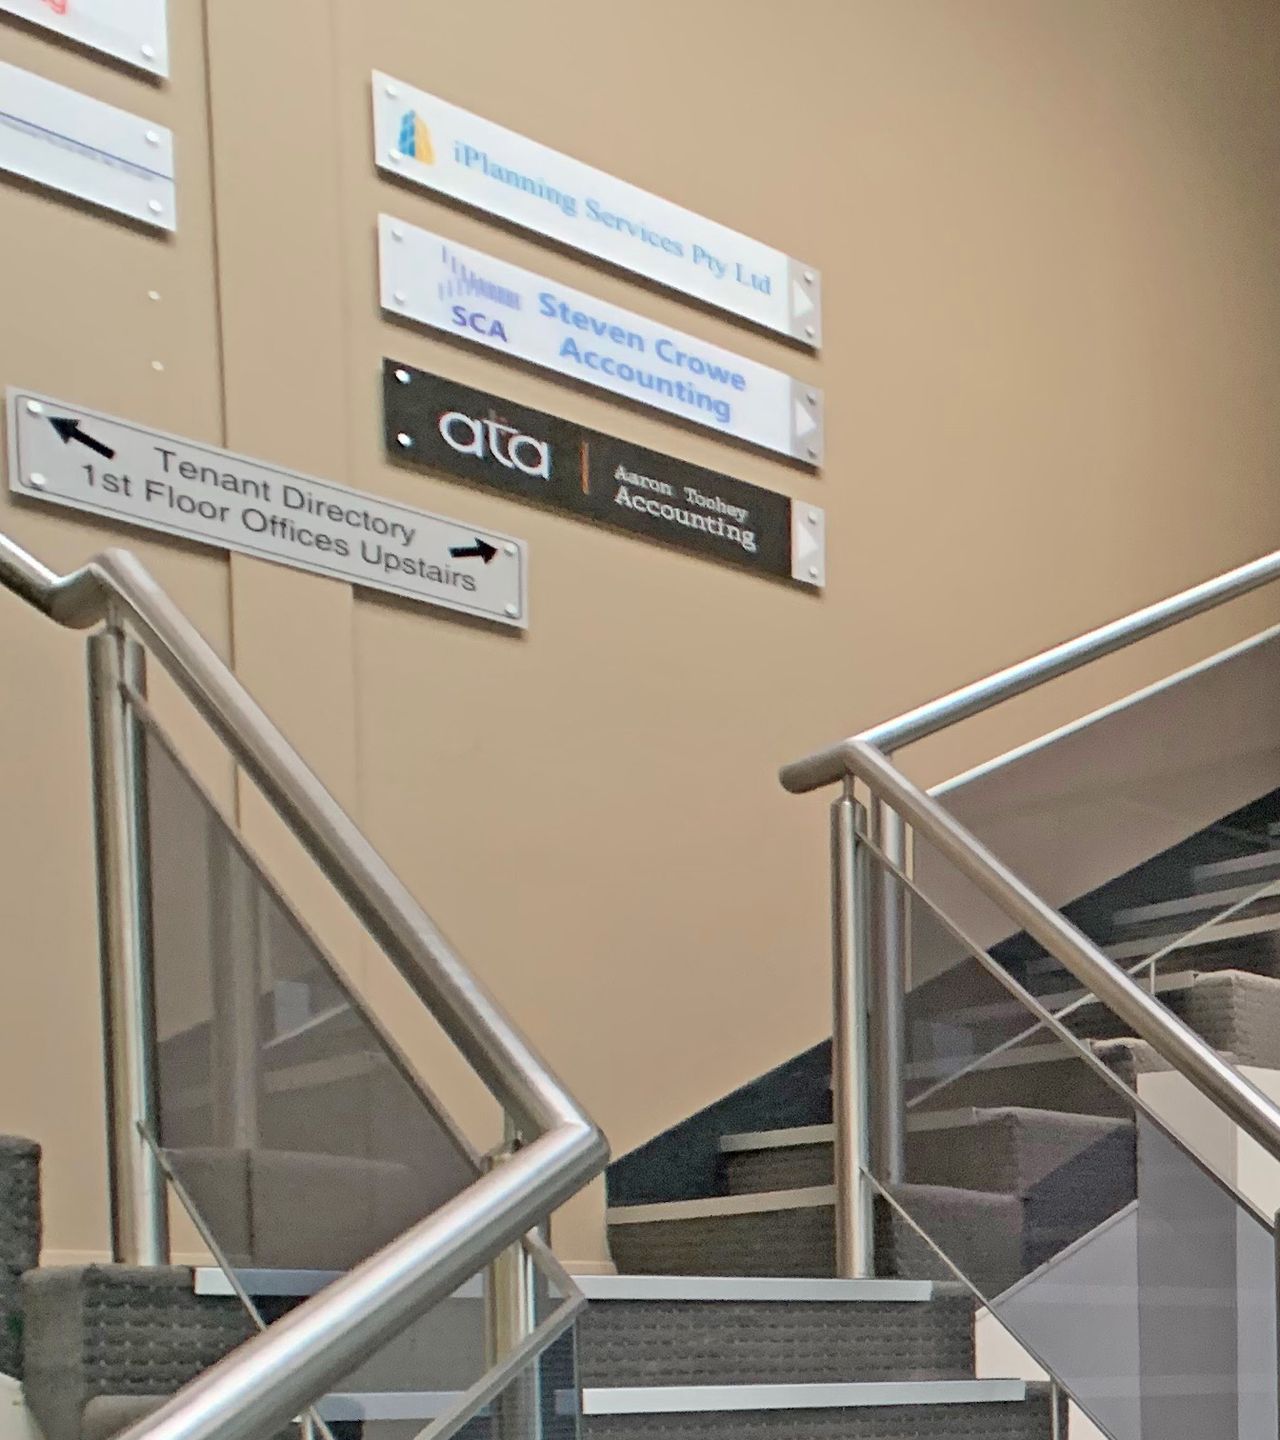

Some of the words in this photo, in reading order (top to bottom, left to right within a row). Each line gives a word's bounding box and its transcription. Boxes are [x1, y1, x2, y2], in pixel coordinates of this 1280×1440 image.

[453, 140, 577, 217] iPlanning
[585, 198, 683, 258] Services
[692, 244, 727, 279] Pty
[735, 262, 772, 296] Ltd
[451, 305, 509, 343] SCA
[539, 291, 645, 352] Steven
[655, 338, 747, 392] Crowe
[559, 337, 732, 424] Accounting
[437, 408, 553, 481] ata
[614, 464, 673, 497] Aaron
[81, 463, 131, 496] 1st
[145, 480, 230, 522] Floor
[241, 508, 350, 557] Offices
[361, 540, 477, 593] Upstairs
[154, 446, 271, 502] Tenant
[283, 484, 416, 546] Directory
[613, 484, 757, 553] Accounting
